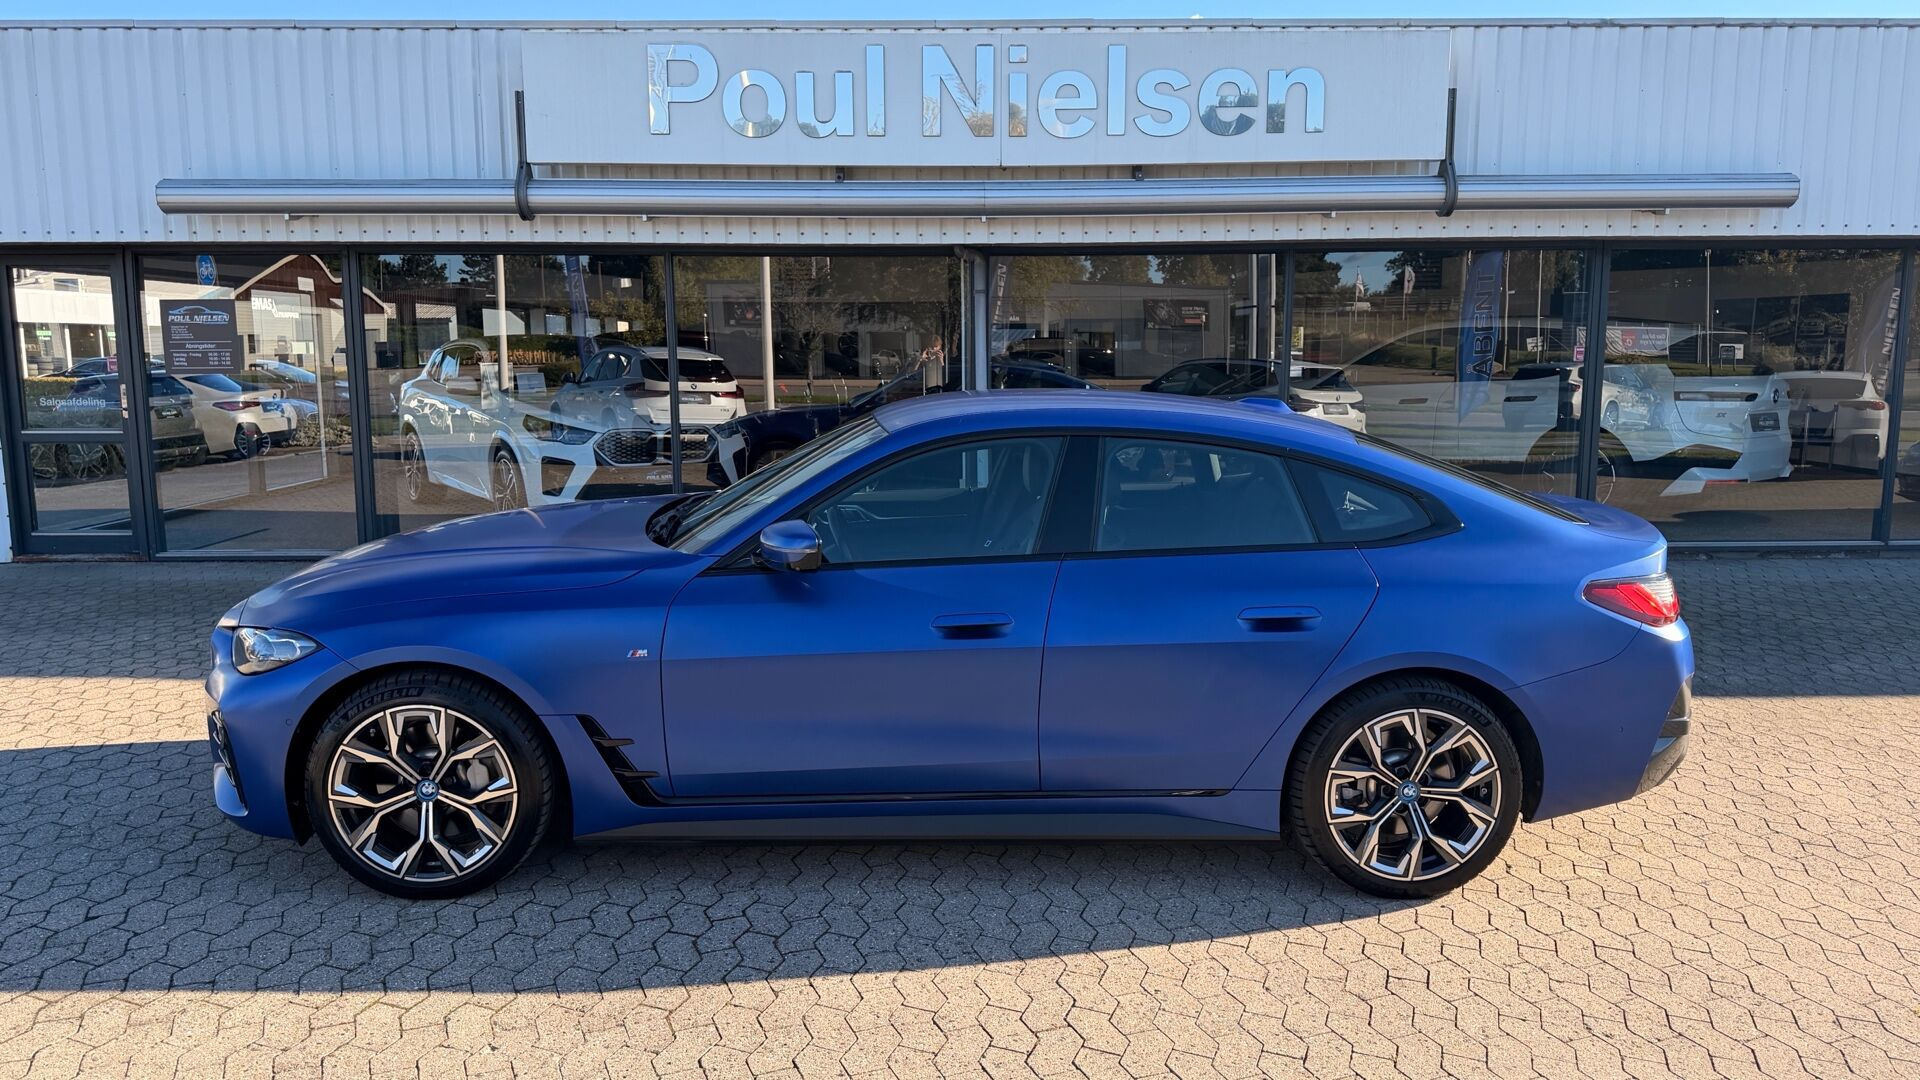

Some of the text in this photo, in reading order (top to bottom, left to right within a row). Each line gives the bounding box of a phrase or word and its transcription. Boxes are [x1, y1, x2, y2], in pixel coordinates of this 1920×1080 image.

[647, 43, 1325, 138] Poul Nielsen
[168, 314, 229, 323] POUL NIELSEN
[1466, 274, 1495, 378] ÅBENT
[1882, 287, 1901, 355] NIELSEN
[39, 397, 106, 408] Salgsafdeling
[348, 686, 420, 719] MICHELIN
